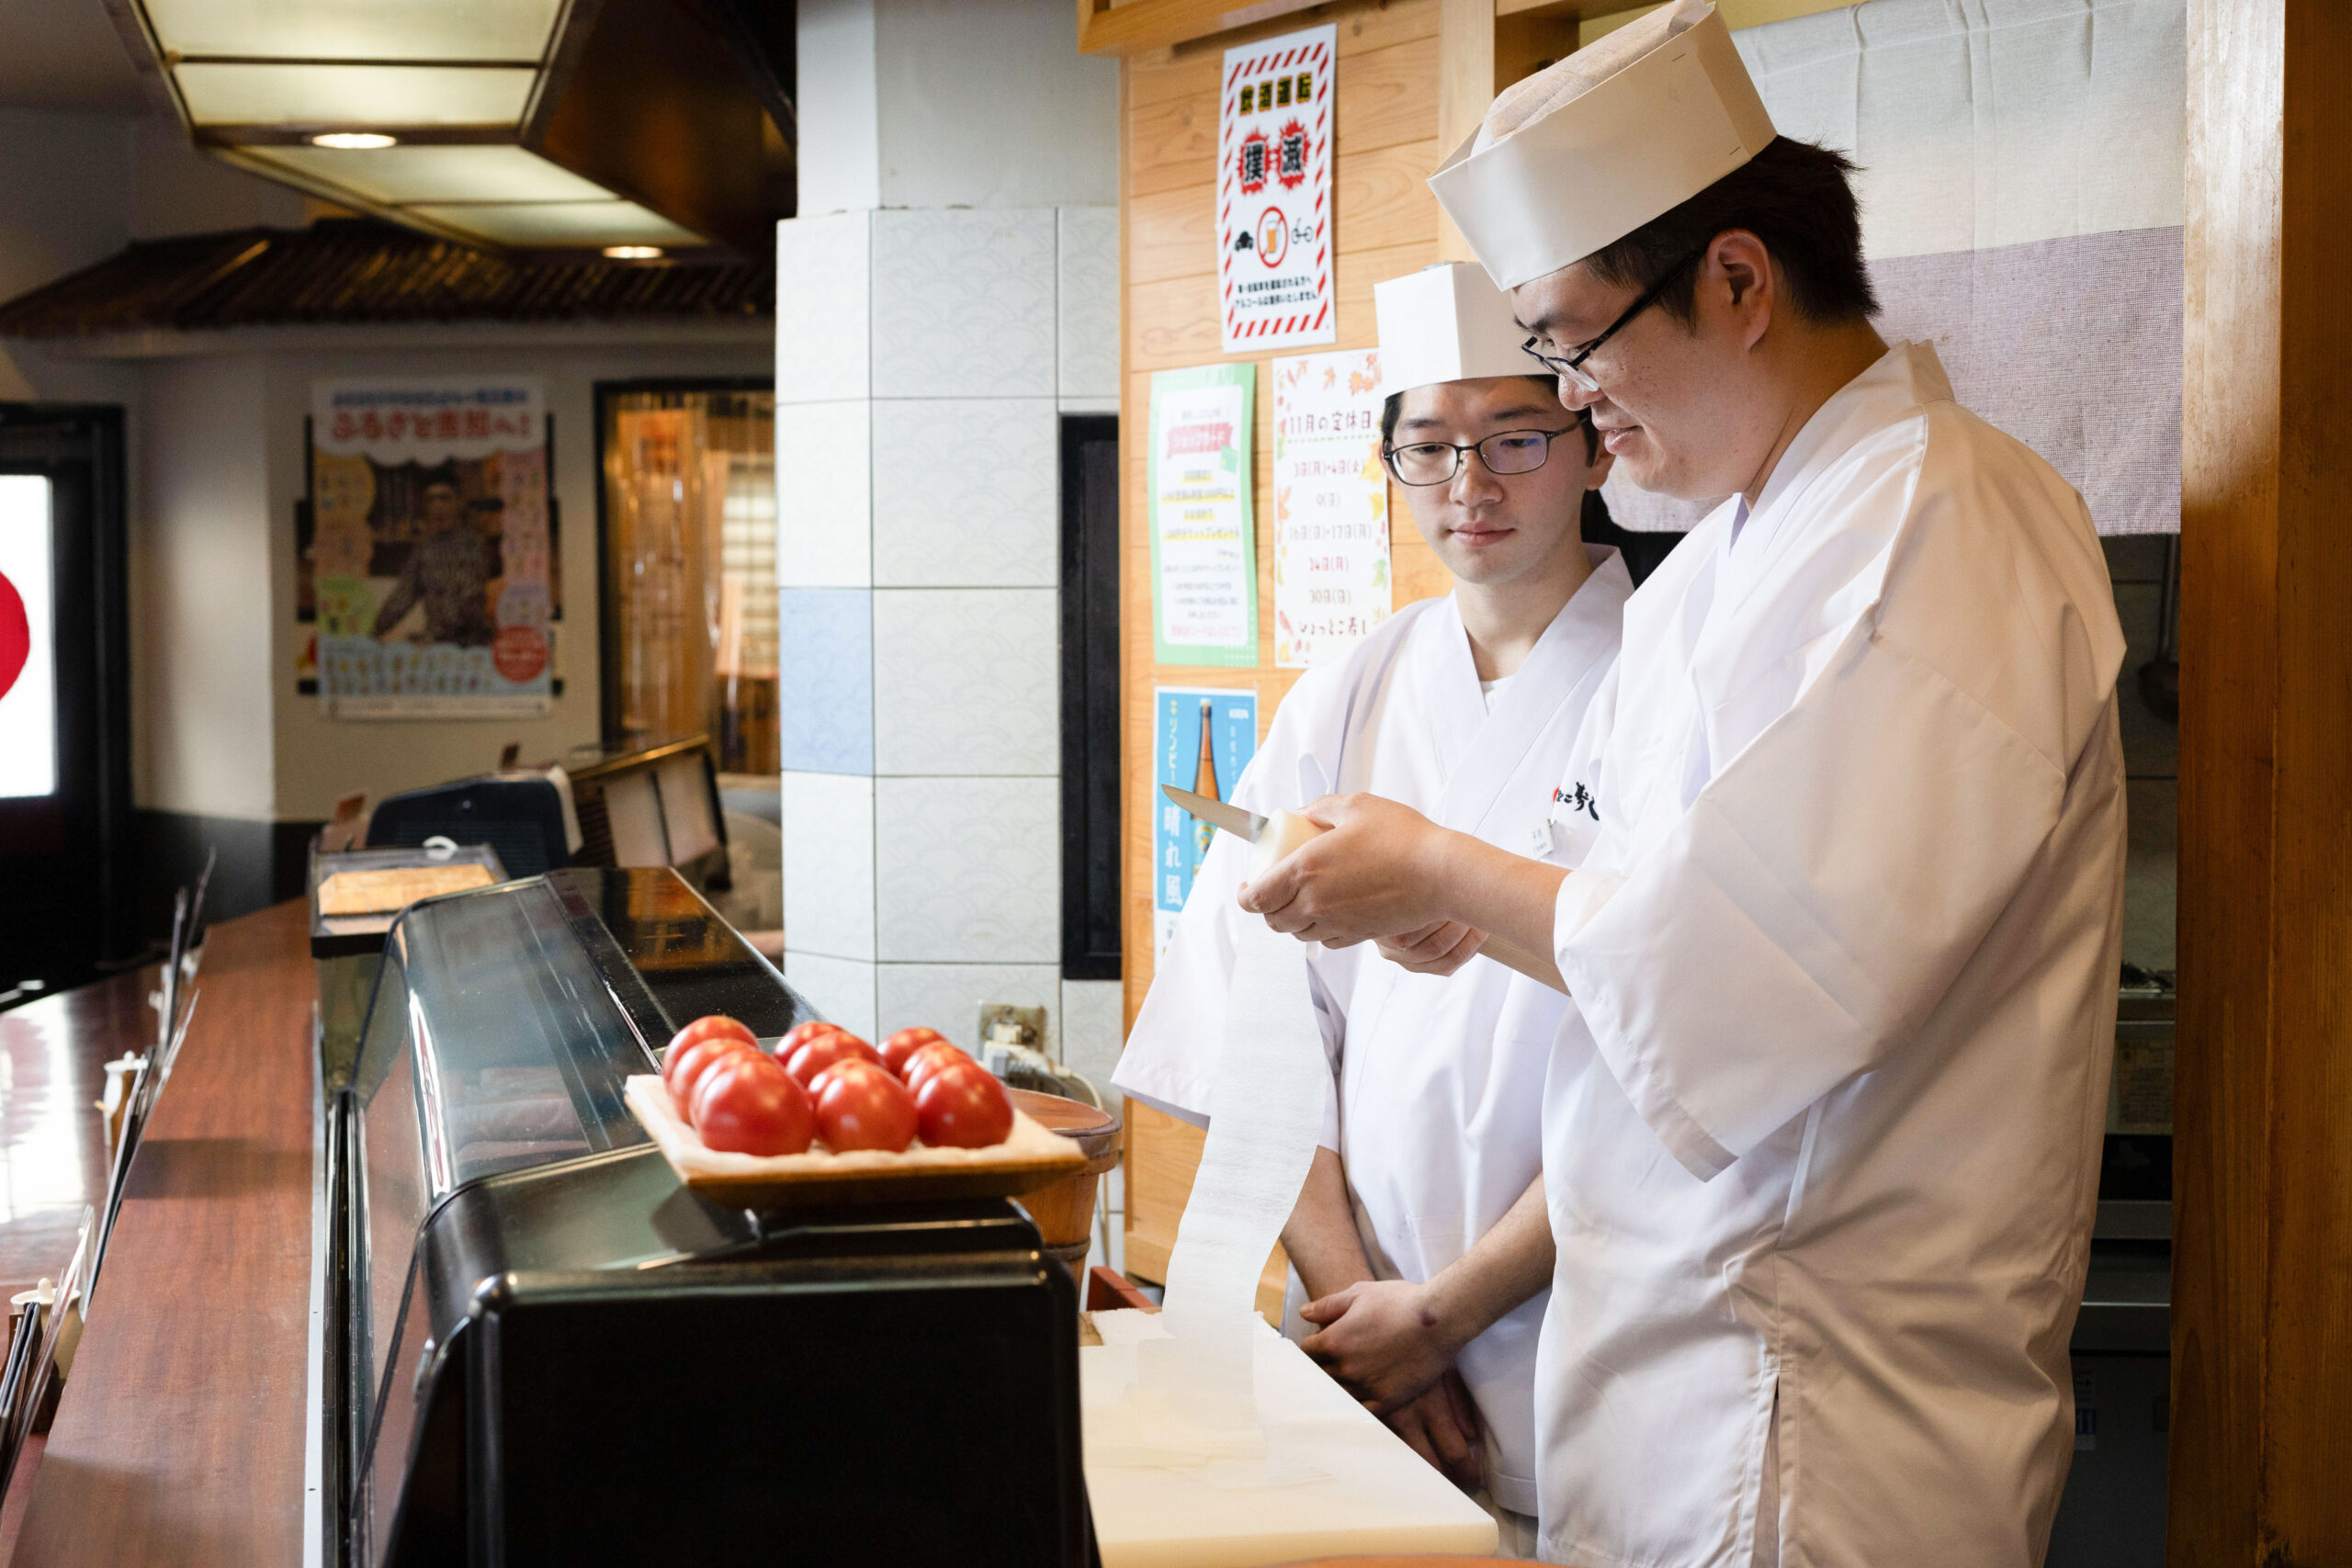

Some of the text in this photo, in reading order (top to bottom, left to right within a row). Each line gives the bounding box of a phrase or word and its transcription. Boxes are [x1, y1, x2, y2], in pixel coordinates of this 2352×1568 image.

[1244, 134, 1303, 184] 撲滅
[1290, 410, 1372, 434] 11月の定休日
[1168, 699, 1179, 788] キリンビー
[1163, 804, 1183, 907] 晴れ風
